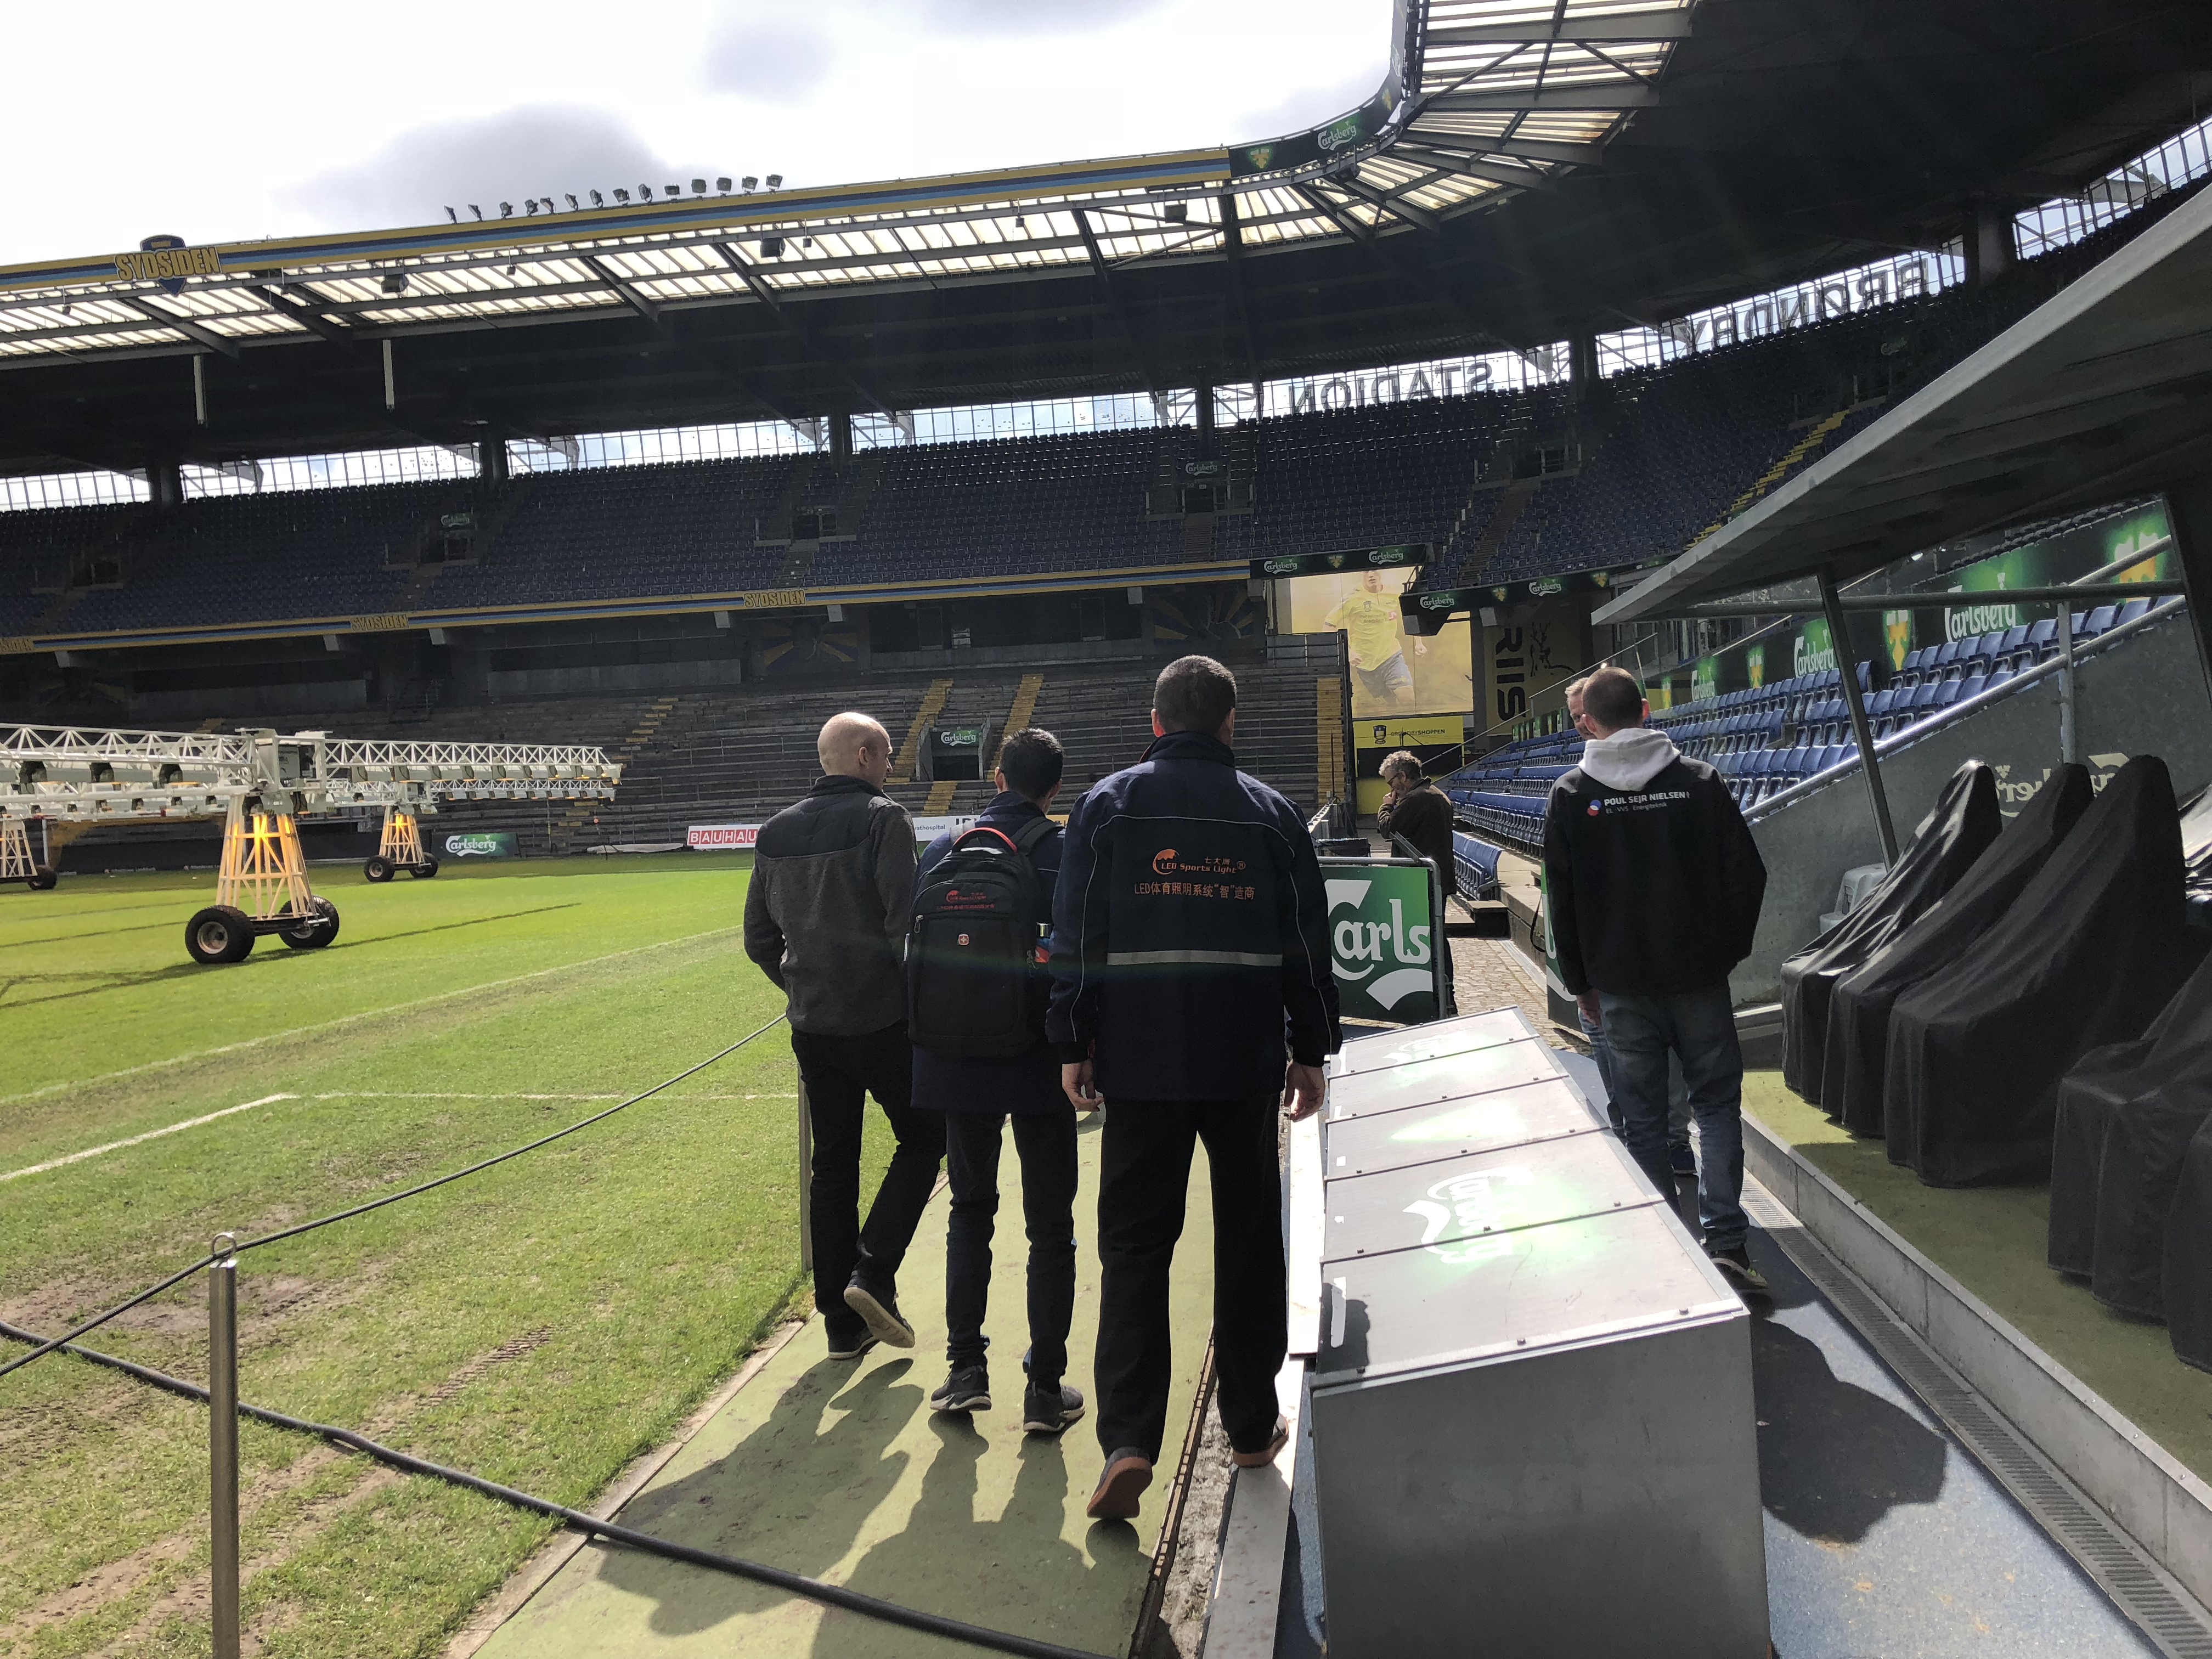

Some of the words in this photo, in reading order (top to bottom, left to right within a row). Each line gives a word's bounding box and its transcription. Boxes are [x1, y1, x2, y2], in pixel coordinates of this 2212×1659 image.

[1318, 123, 1357, 151] Carlsberg
[116, 247, 219, 281] SYDSIDEN
[1185, 462, 1217, 476] Carlsberg
[1368, 550, 1403, 565] Carlsberg
[1263, 560, 1297, 574] Carlsberg
[1529, 580, 1562, 597] Carlsberg
[744, 590, 805, 608] SYDSIDEN
[1420, 595, 1455, 611] Carlsberg
[350, 614, 409, 632] SYDSIDEN
[940, 731, 977, 747] Carlsberg
[1604, 797, 1627, 806] POUL
[1628, 794, 1648, 804] SEJR
[1649, 792, 1686, 801] NIELSEN
[445, 834, 496, 857] Carlsberg
[1180, 863, 1211, 872] Sports
[1213, 865, 1237, 874] Light
